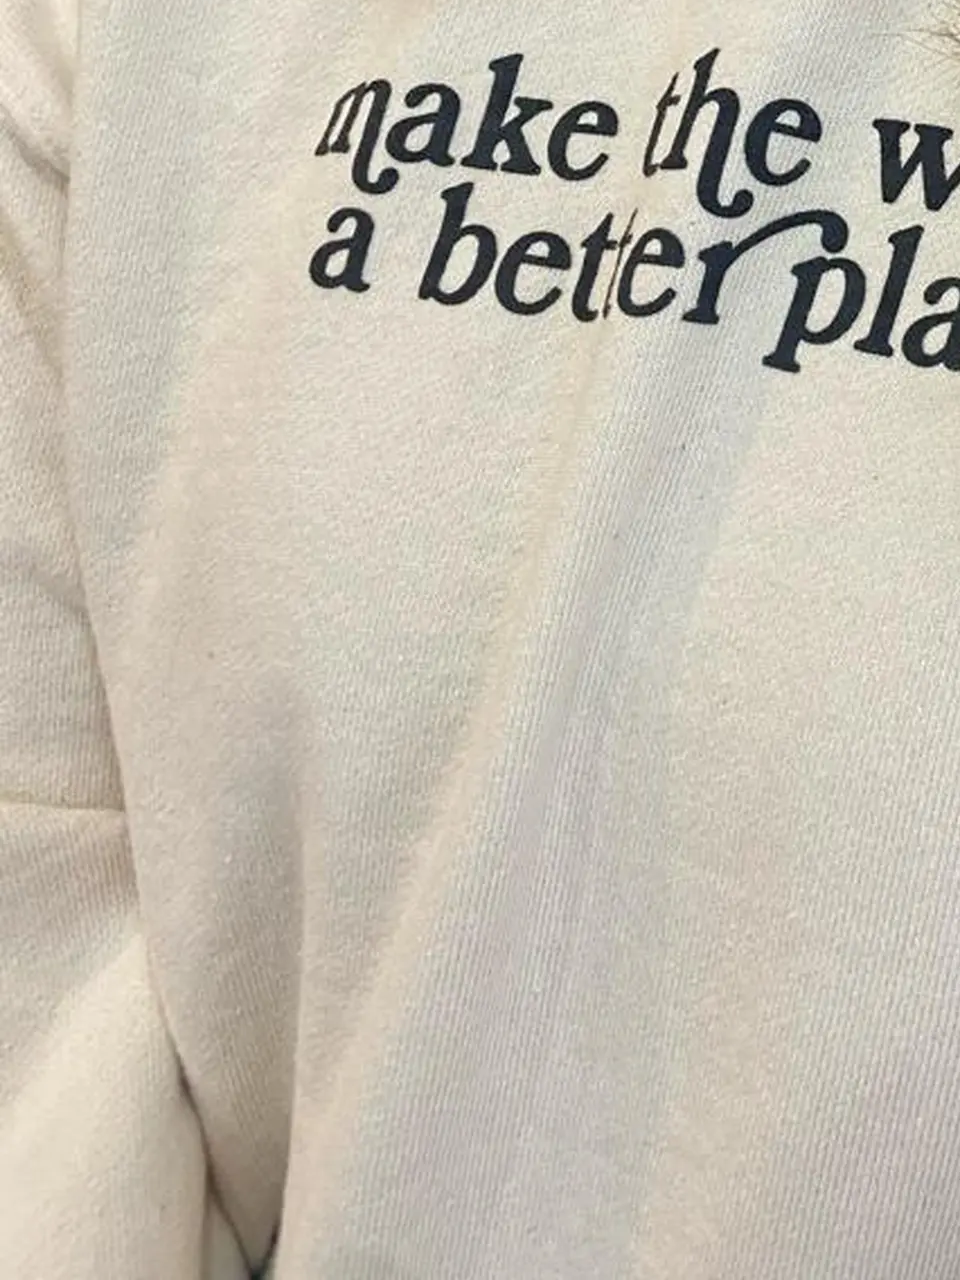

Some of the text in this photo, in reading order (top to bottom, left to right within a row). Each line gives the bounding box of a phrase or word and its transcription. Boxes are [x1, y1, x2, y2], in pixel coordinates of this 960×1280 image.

[314, 53, 620, 195] make
[642, 48, 823, 219] the
[309, 207, 375, 294] a
